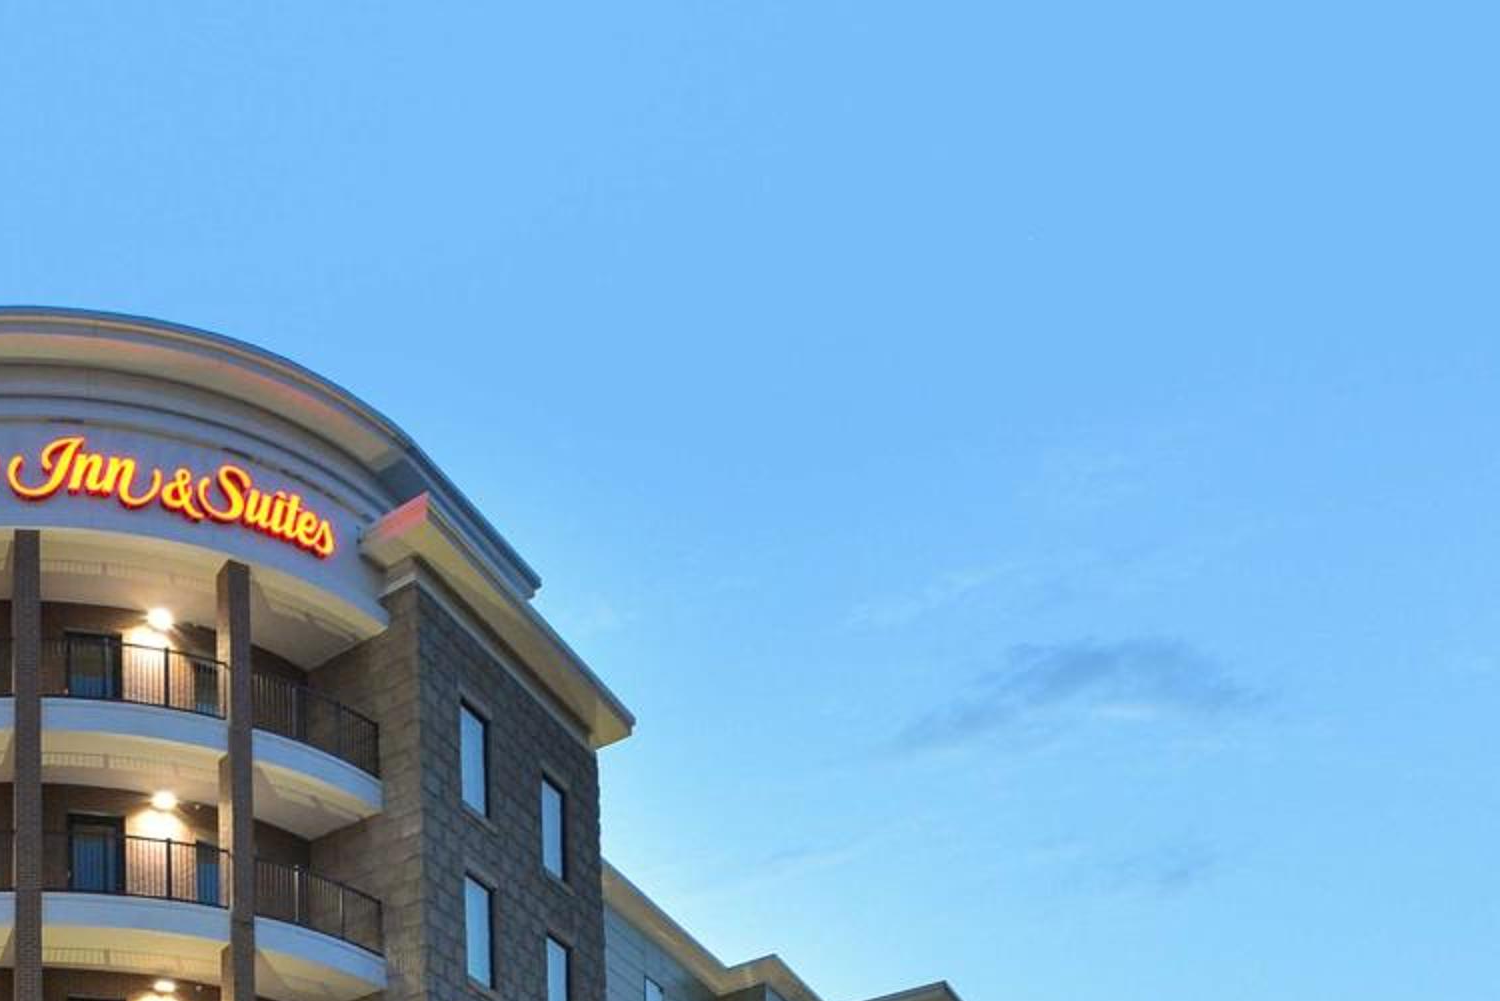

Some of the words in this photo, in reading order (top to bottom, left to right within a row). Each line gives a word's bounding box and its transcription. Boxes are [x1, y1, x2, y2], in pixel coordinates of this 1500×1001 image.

[7, 435, 162, 508] Inn
[161, 468, 204, 523] &
[197, 464, 334, 557] Suites
